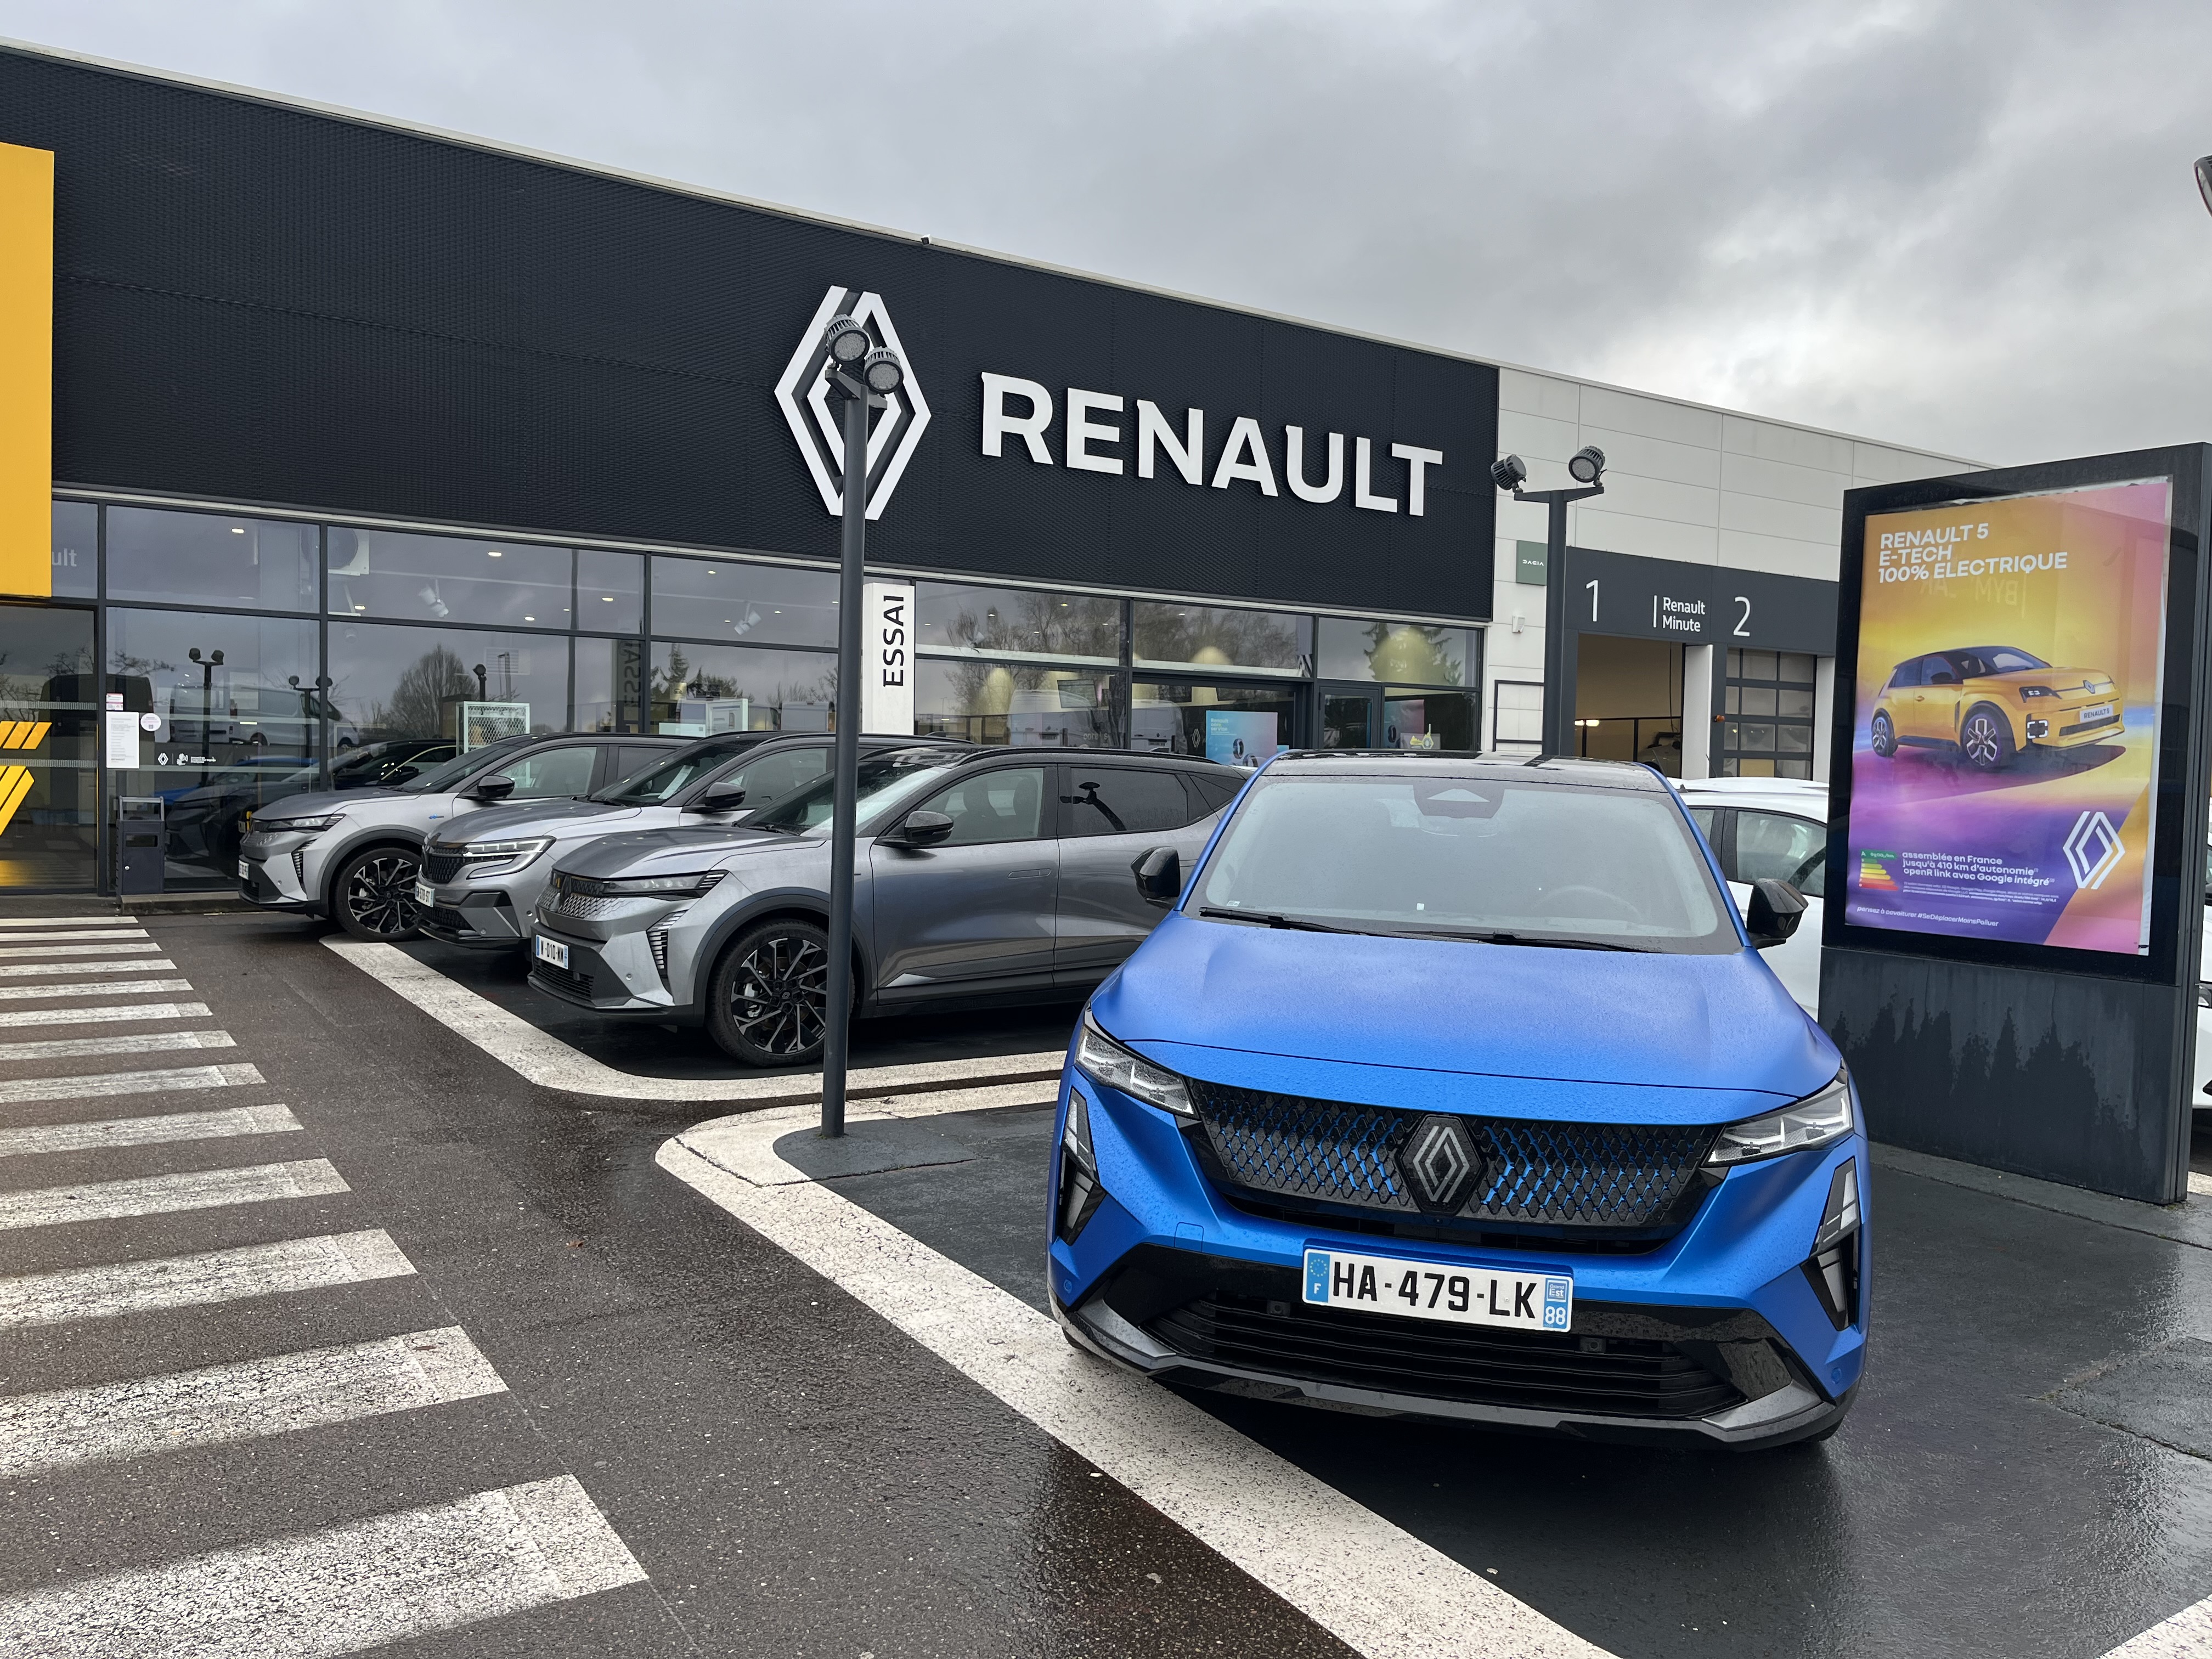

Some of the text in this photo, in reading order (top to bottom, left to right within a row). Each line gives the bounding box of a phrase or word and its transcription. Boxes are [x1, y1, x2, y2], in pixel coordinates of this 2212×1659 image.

[981, 371, 1443, 517] RENAULT
[1880, 523, 1989, 549] RENAULT 5
[1879, 544, 1953, 566] E-TECH
[1878, 552, 2068, 583] 100% ELECTRIQUE
[1585, 579, 1599, 622] 1
[1663, 596, 1706, 615] Renault
[1662, 614, 1701, 632] Minute
[1733, 596, 1751, 637] 2
[883, 595, 905, 687] ESSAI
[2084, 708, 2107, 719] RENAULT
[1902, 852, 1953, 861] assemblée
[1967, 855, 2002, 865] France
[1903, 859, 1936, 868] jusqu'à
[1937, 861, 1952, 870] 410
[1954, 862, 1968, 871] km
[1904, 868, 1933, 877] openR
[1934, 869, 1950, 878] link
[1952, 872, 1976, 880] avec
[1977, 873, 2013, 884] Google
[1886, 910, 1917, 918] covoiturer
[1314, 1283, 1322, 1294] F
[1333, 1261, 1537, 1319] HA-479-LK
[1549, 1289, 1564, 1297] Est
[1545, 1306, 1566, 1325] 88
